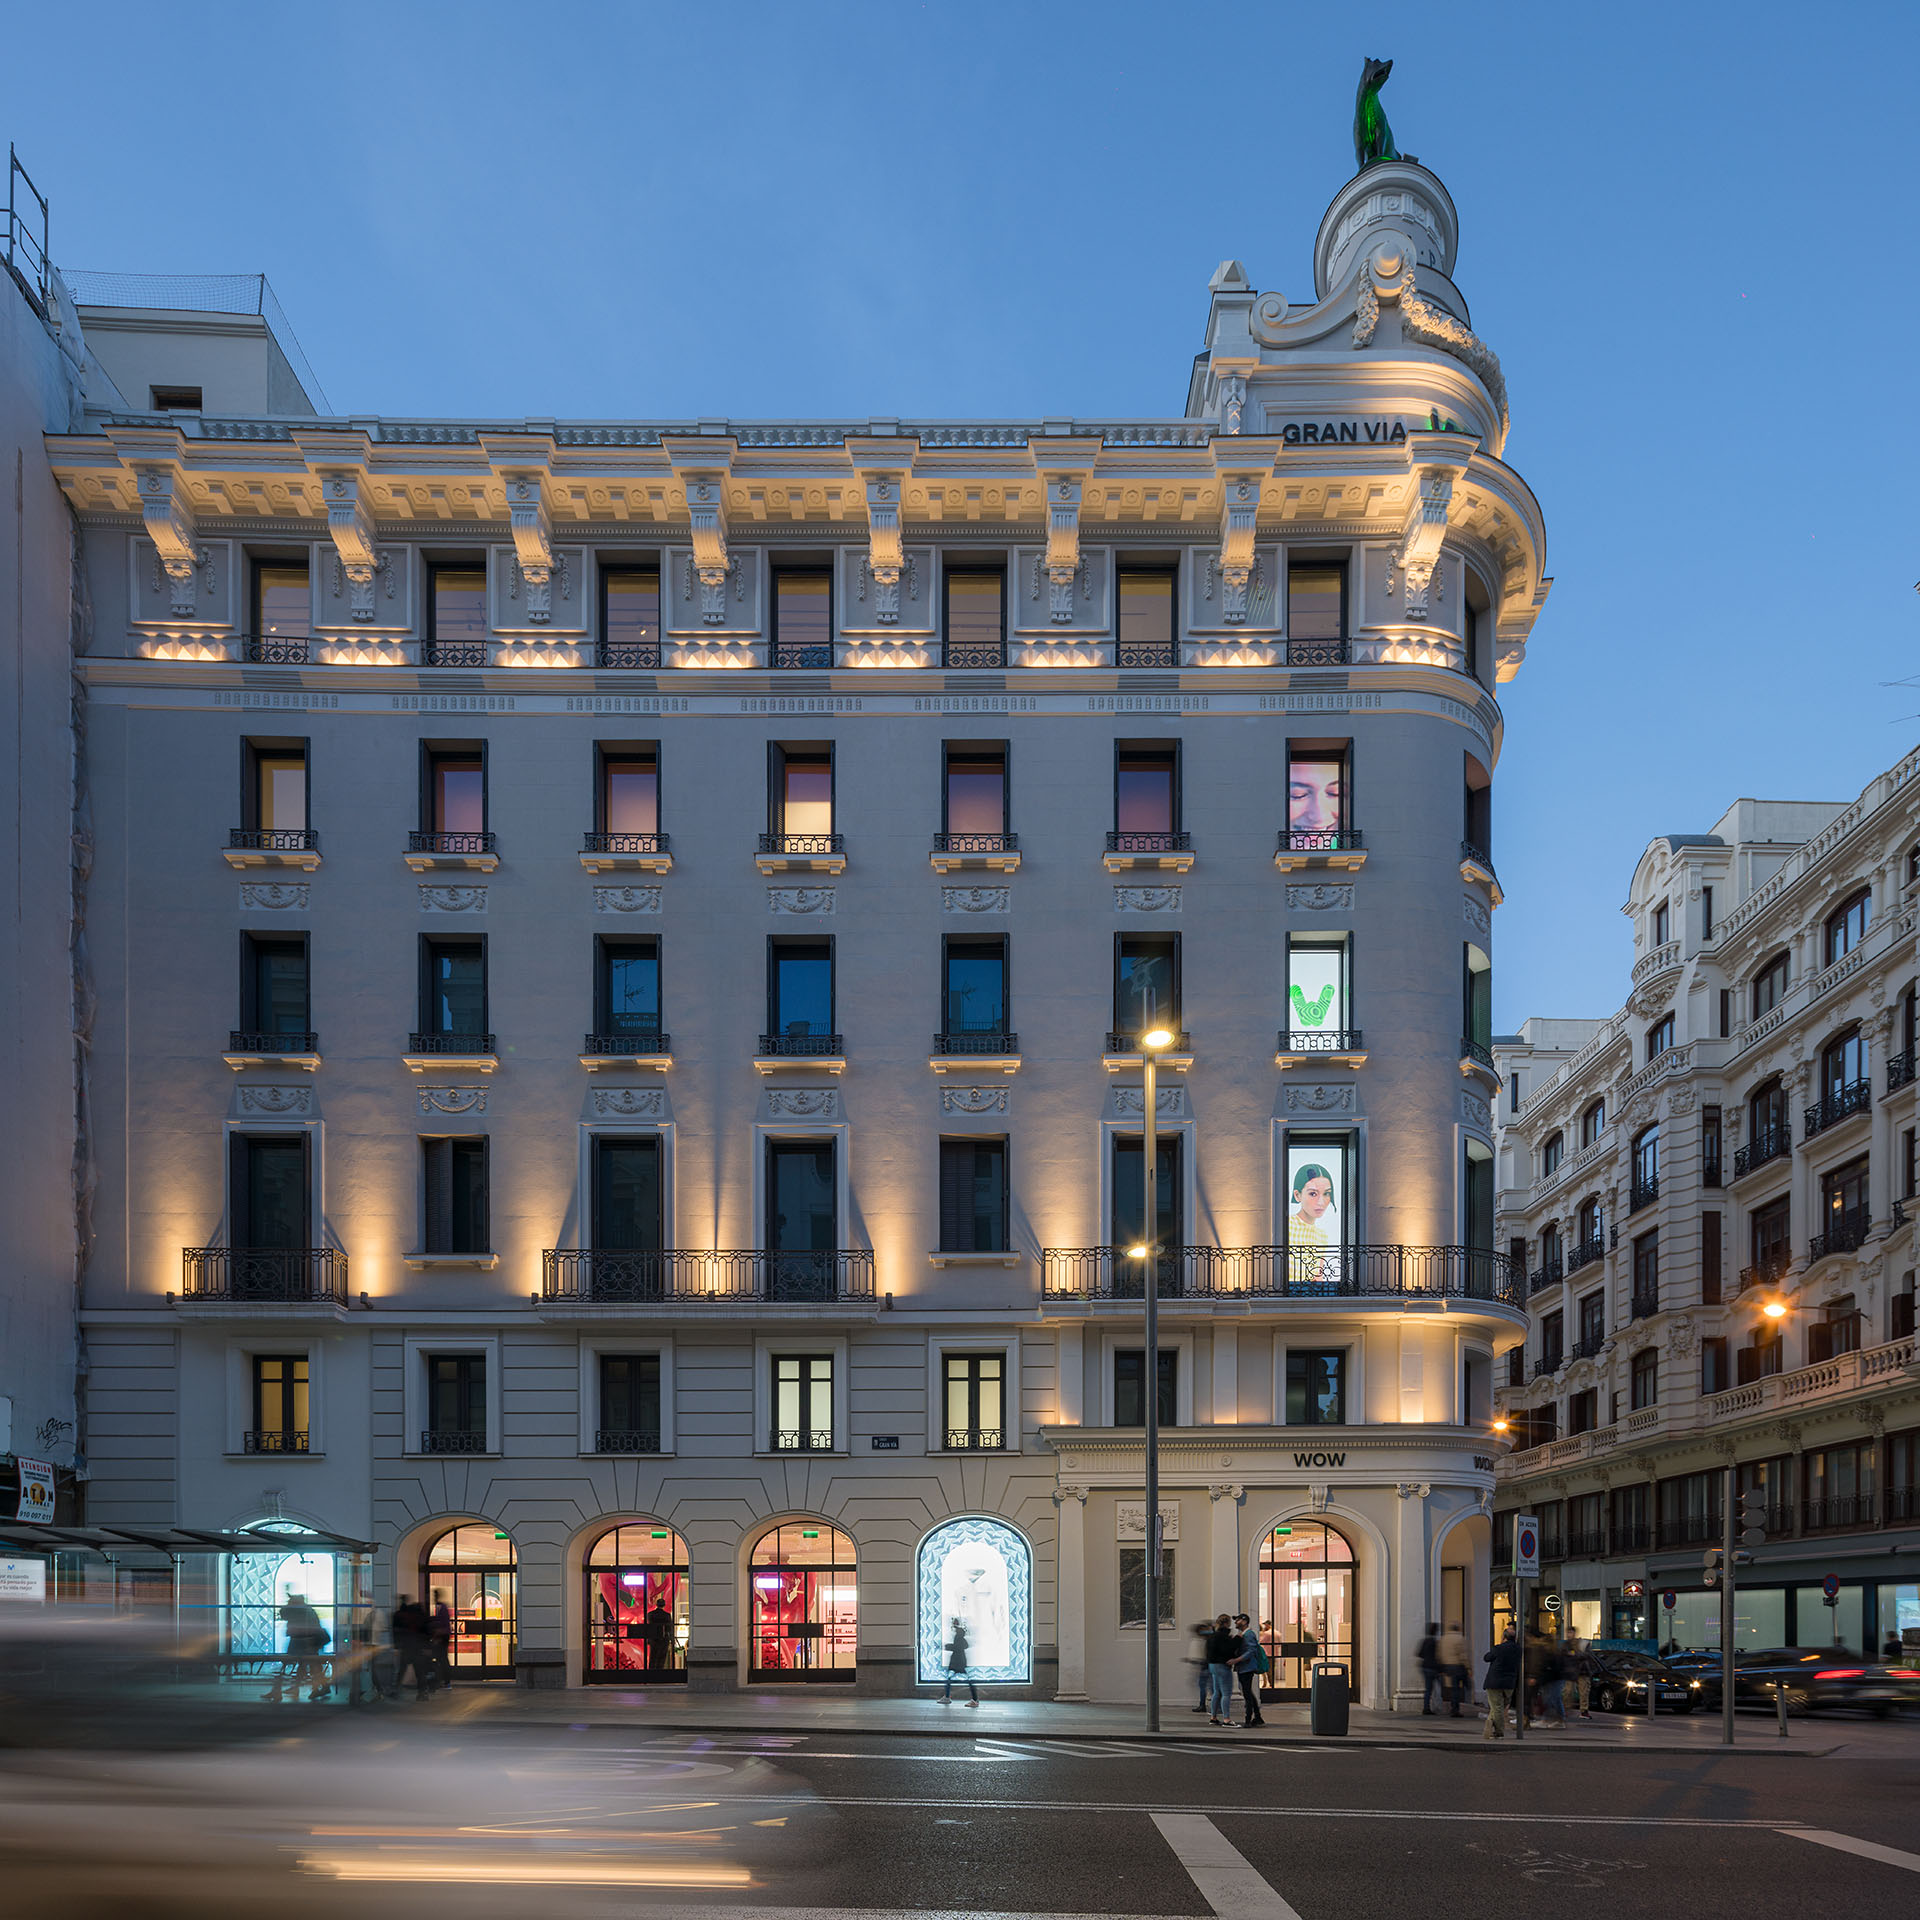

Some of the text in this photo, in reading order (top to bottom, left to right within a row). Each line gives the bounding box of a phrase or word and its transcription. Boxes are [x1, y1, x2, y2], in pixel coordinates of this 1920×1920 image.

[1282, 422, 1406, 443] GRAN VIA
[1293, 1452, 1346, 1467] WOW
